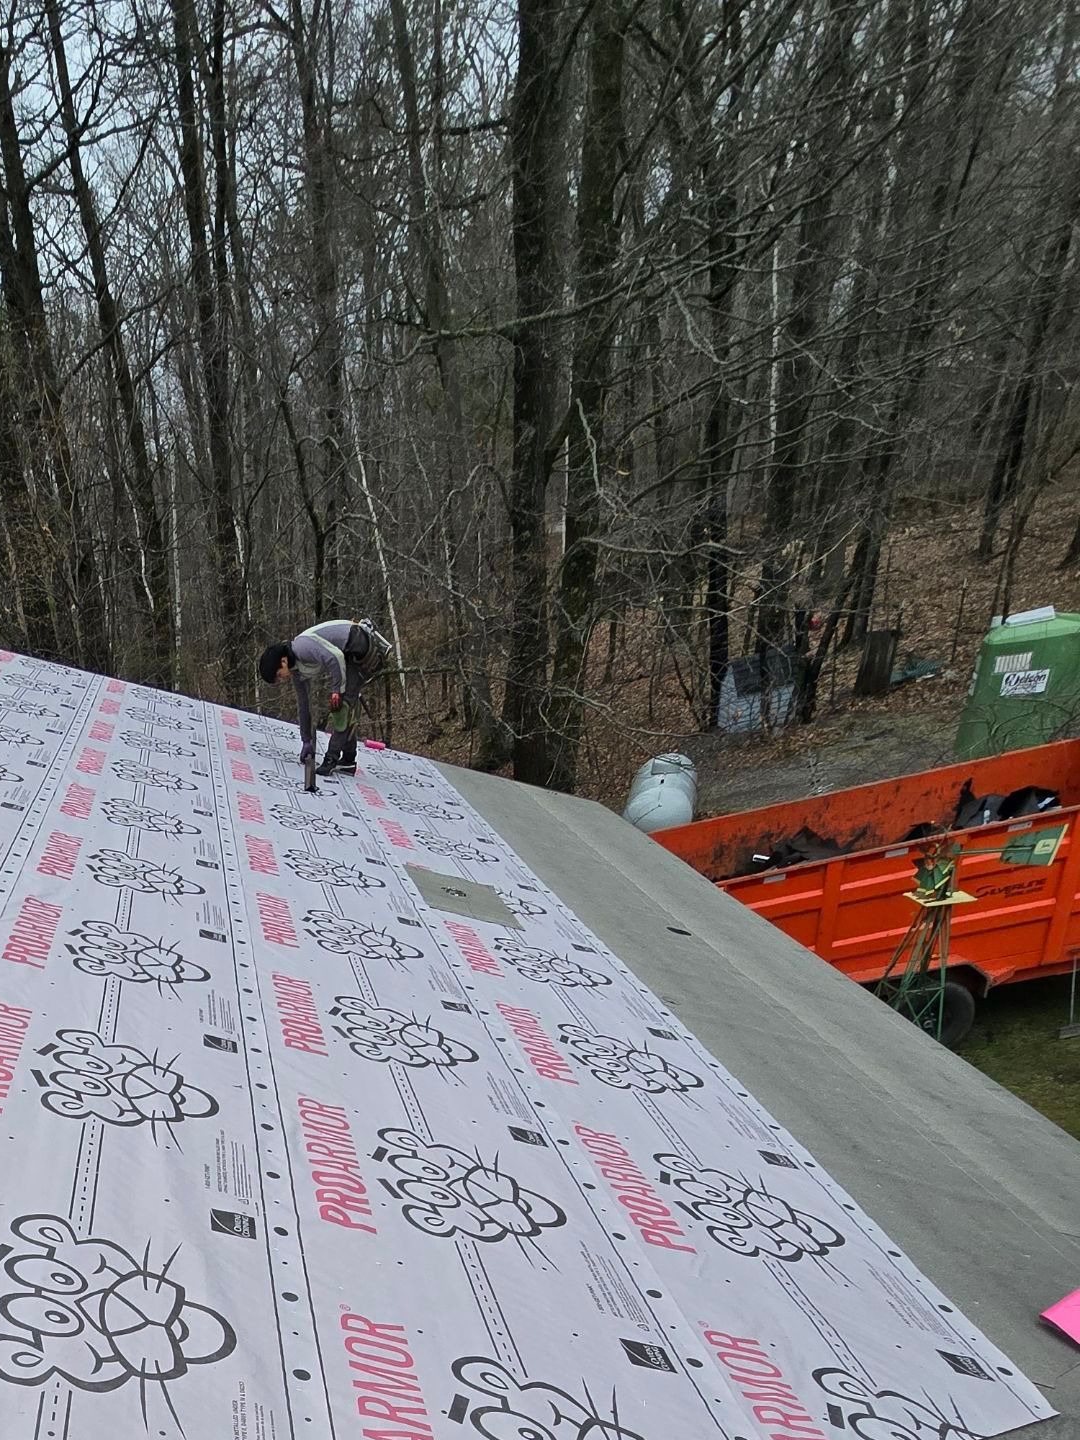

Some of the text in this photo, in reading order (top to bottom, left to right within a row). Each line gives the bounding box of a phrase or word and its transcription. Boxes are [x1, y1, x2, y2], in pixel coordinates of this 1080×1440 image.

[2, 895, 63, 969] PROARMOR
[272, 971, 328, 1056] PROARMOR
[496, 1001, 579, 1086] PROARMOR
